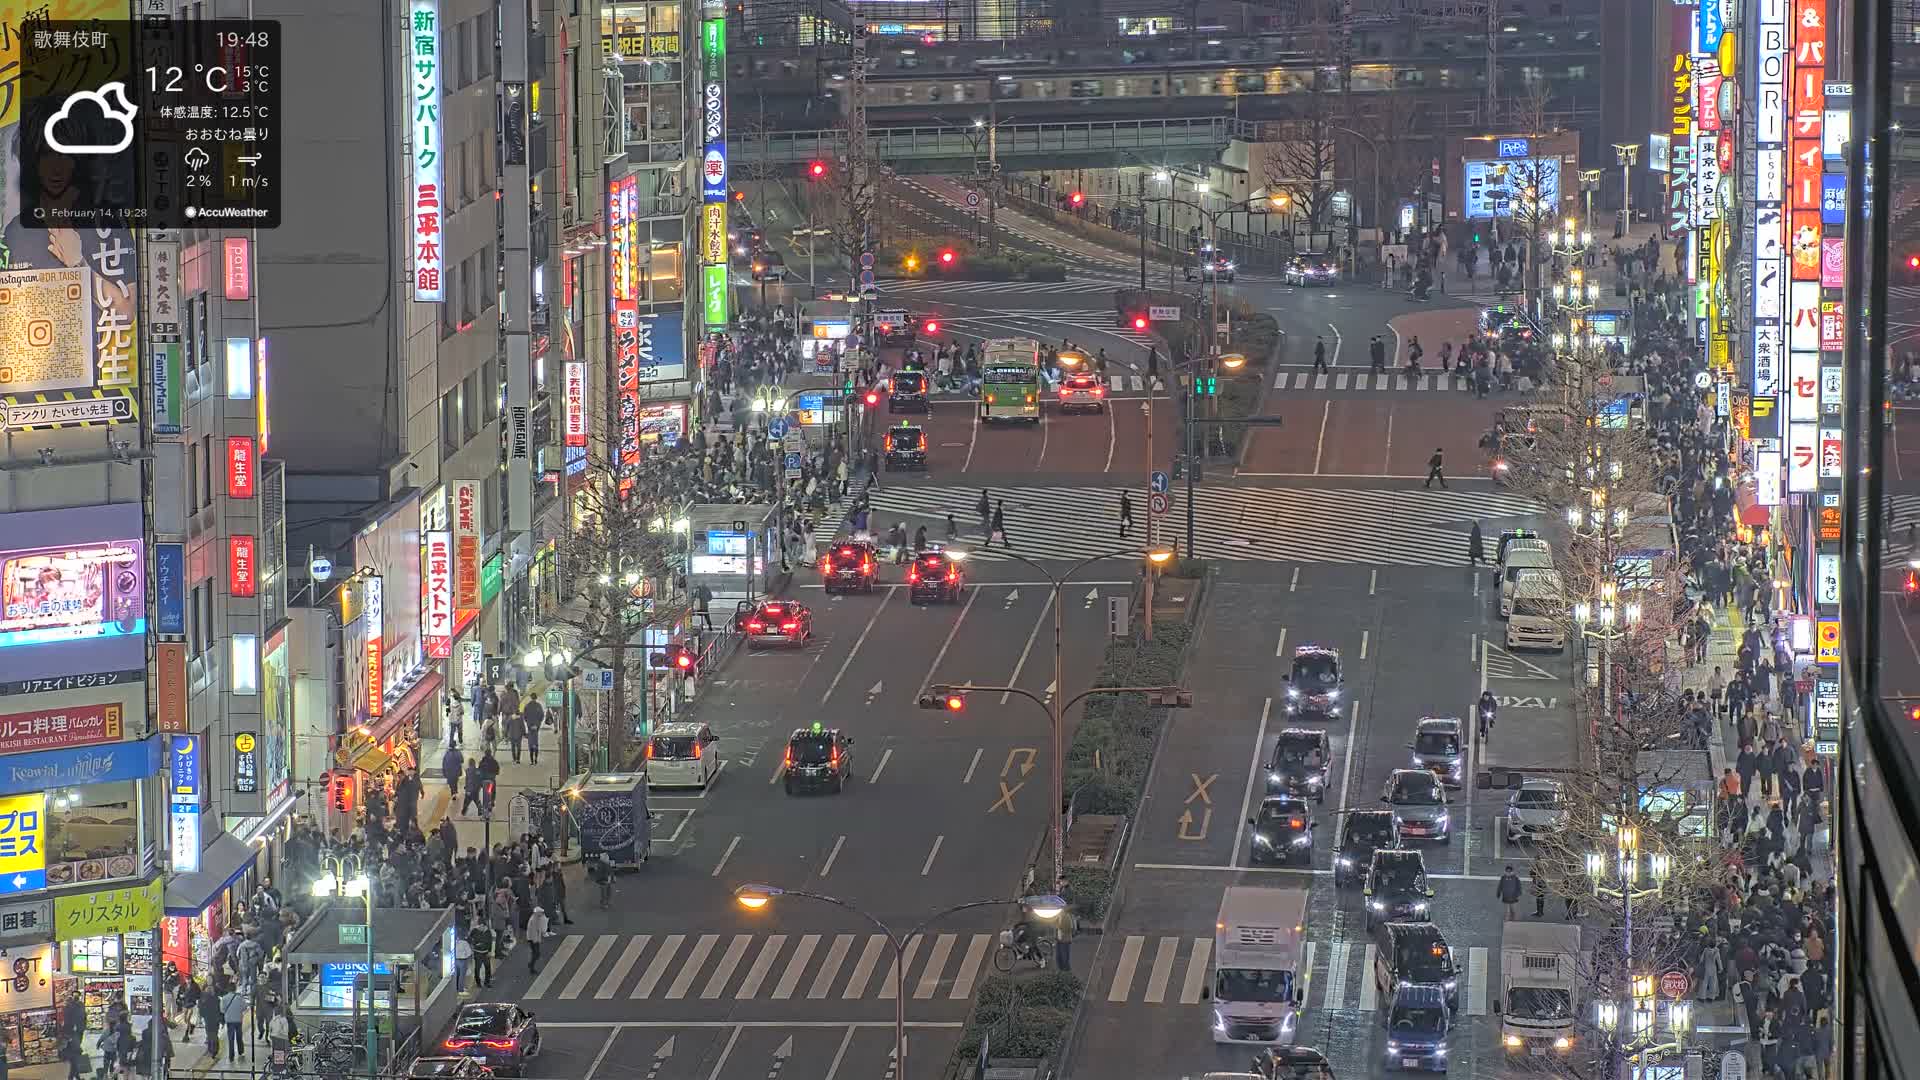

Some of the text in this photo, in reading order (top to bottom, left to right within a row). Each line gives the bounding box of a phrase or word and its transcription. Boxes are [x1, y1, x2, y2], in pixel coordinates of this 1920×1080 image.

[414, 11, 437, 169] 新宿サンパーク
[1673, 52, 1692, 135] パチンコ
[1703, 87, 1717, 117] アコム
[706, 84, 721, 138] もつなべ
[706, 160, 724, 177] 薬
[1702, 143, 1715, 219] 東京ぶらんど
[1671, 146, 1692, 231] エスパス
[417, 184, 440, 291] 三平本館
[709, 207, 722, 262] 肉汁水餃子
[709, 275, 723, 313] レイク
[155, 323, 175, 333] 3F
[619, 331, 637, 387] ラーメン
[1758, 330, 1771, 382] 大衆酒場
[155, 352, 167, 414] FamilyMart
[1793, 307, 1818, 468] パセラ
[12, 405, 110, 422] テンクリ たいせい先生
[512, 407, 526, 459] HOMEGAME
[234, 449, 247, 487] 龍生堂
[459, 487, 470, 530] GAME
[1826, 496, 1837, 504] 3F
[160, 554, 169, 605] ゲウチャイ
[236, 547, 249, 582] 龍生堂
[431, 542, 448, 629] 三平ストア
[431, 636, 441, 644] B1
[0, 715, 68, 739] ルコ料理
[24, 734, 67, 746] RESTAURANT
[1, 811, 38, 834] プロ
[179, 804, 192, 813] 2F
[1, 835, 38, 857] ミス
[2, 910, 38, 932] 囲碁
[67, 902, 141, 927] クリスタル
[330, 963, 382, 971] SUBNAE
